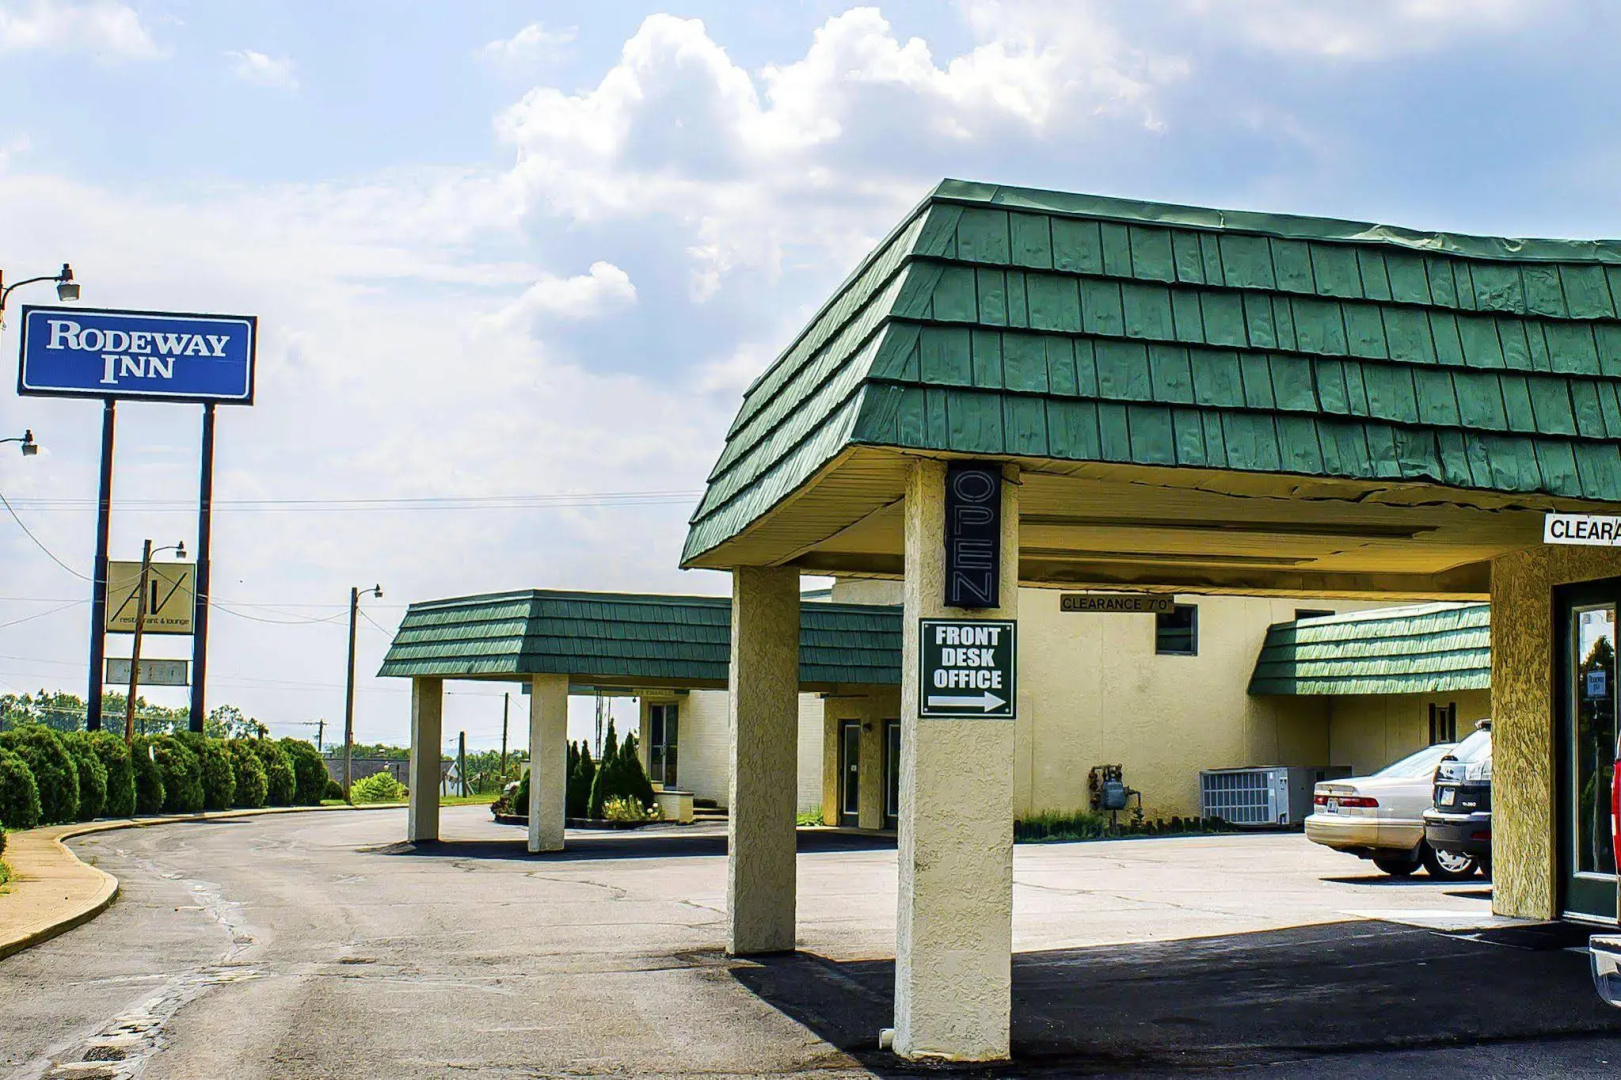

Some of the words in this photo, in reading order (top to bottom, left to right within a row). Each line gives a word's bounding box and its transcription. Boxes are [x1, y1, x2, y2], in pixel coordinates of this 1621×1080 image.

[100, 354, 175, 384] INN
[953, 470, 995, 602] OPEN
[1062, 598, 1142, 610] CLEARANCE
[120, 616, 159, 624] restrant
[167, 617, 190, 626] lounge
[935, 626, 1001, 646] FRONT
[941, 647, 995, 667] DESK
[934, 670, 1002, 689] OFFICE
